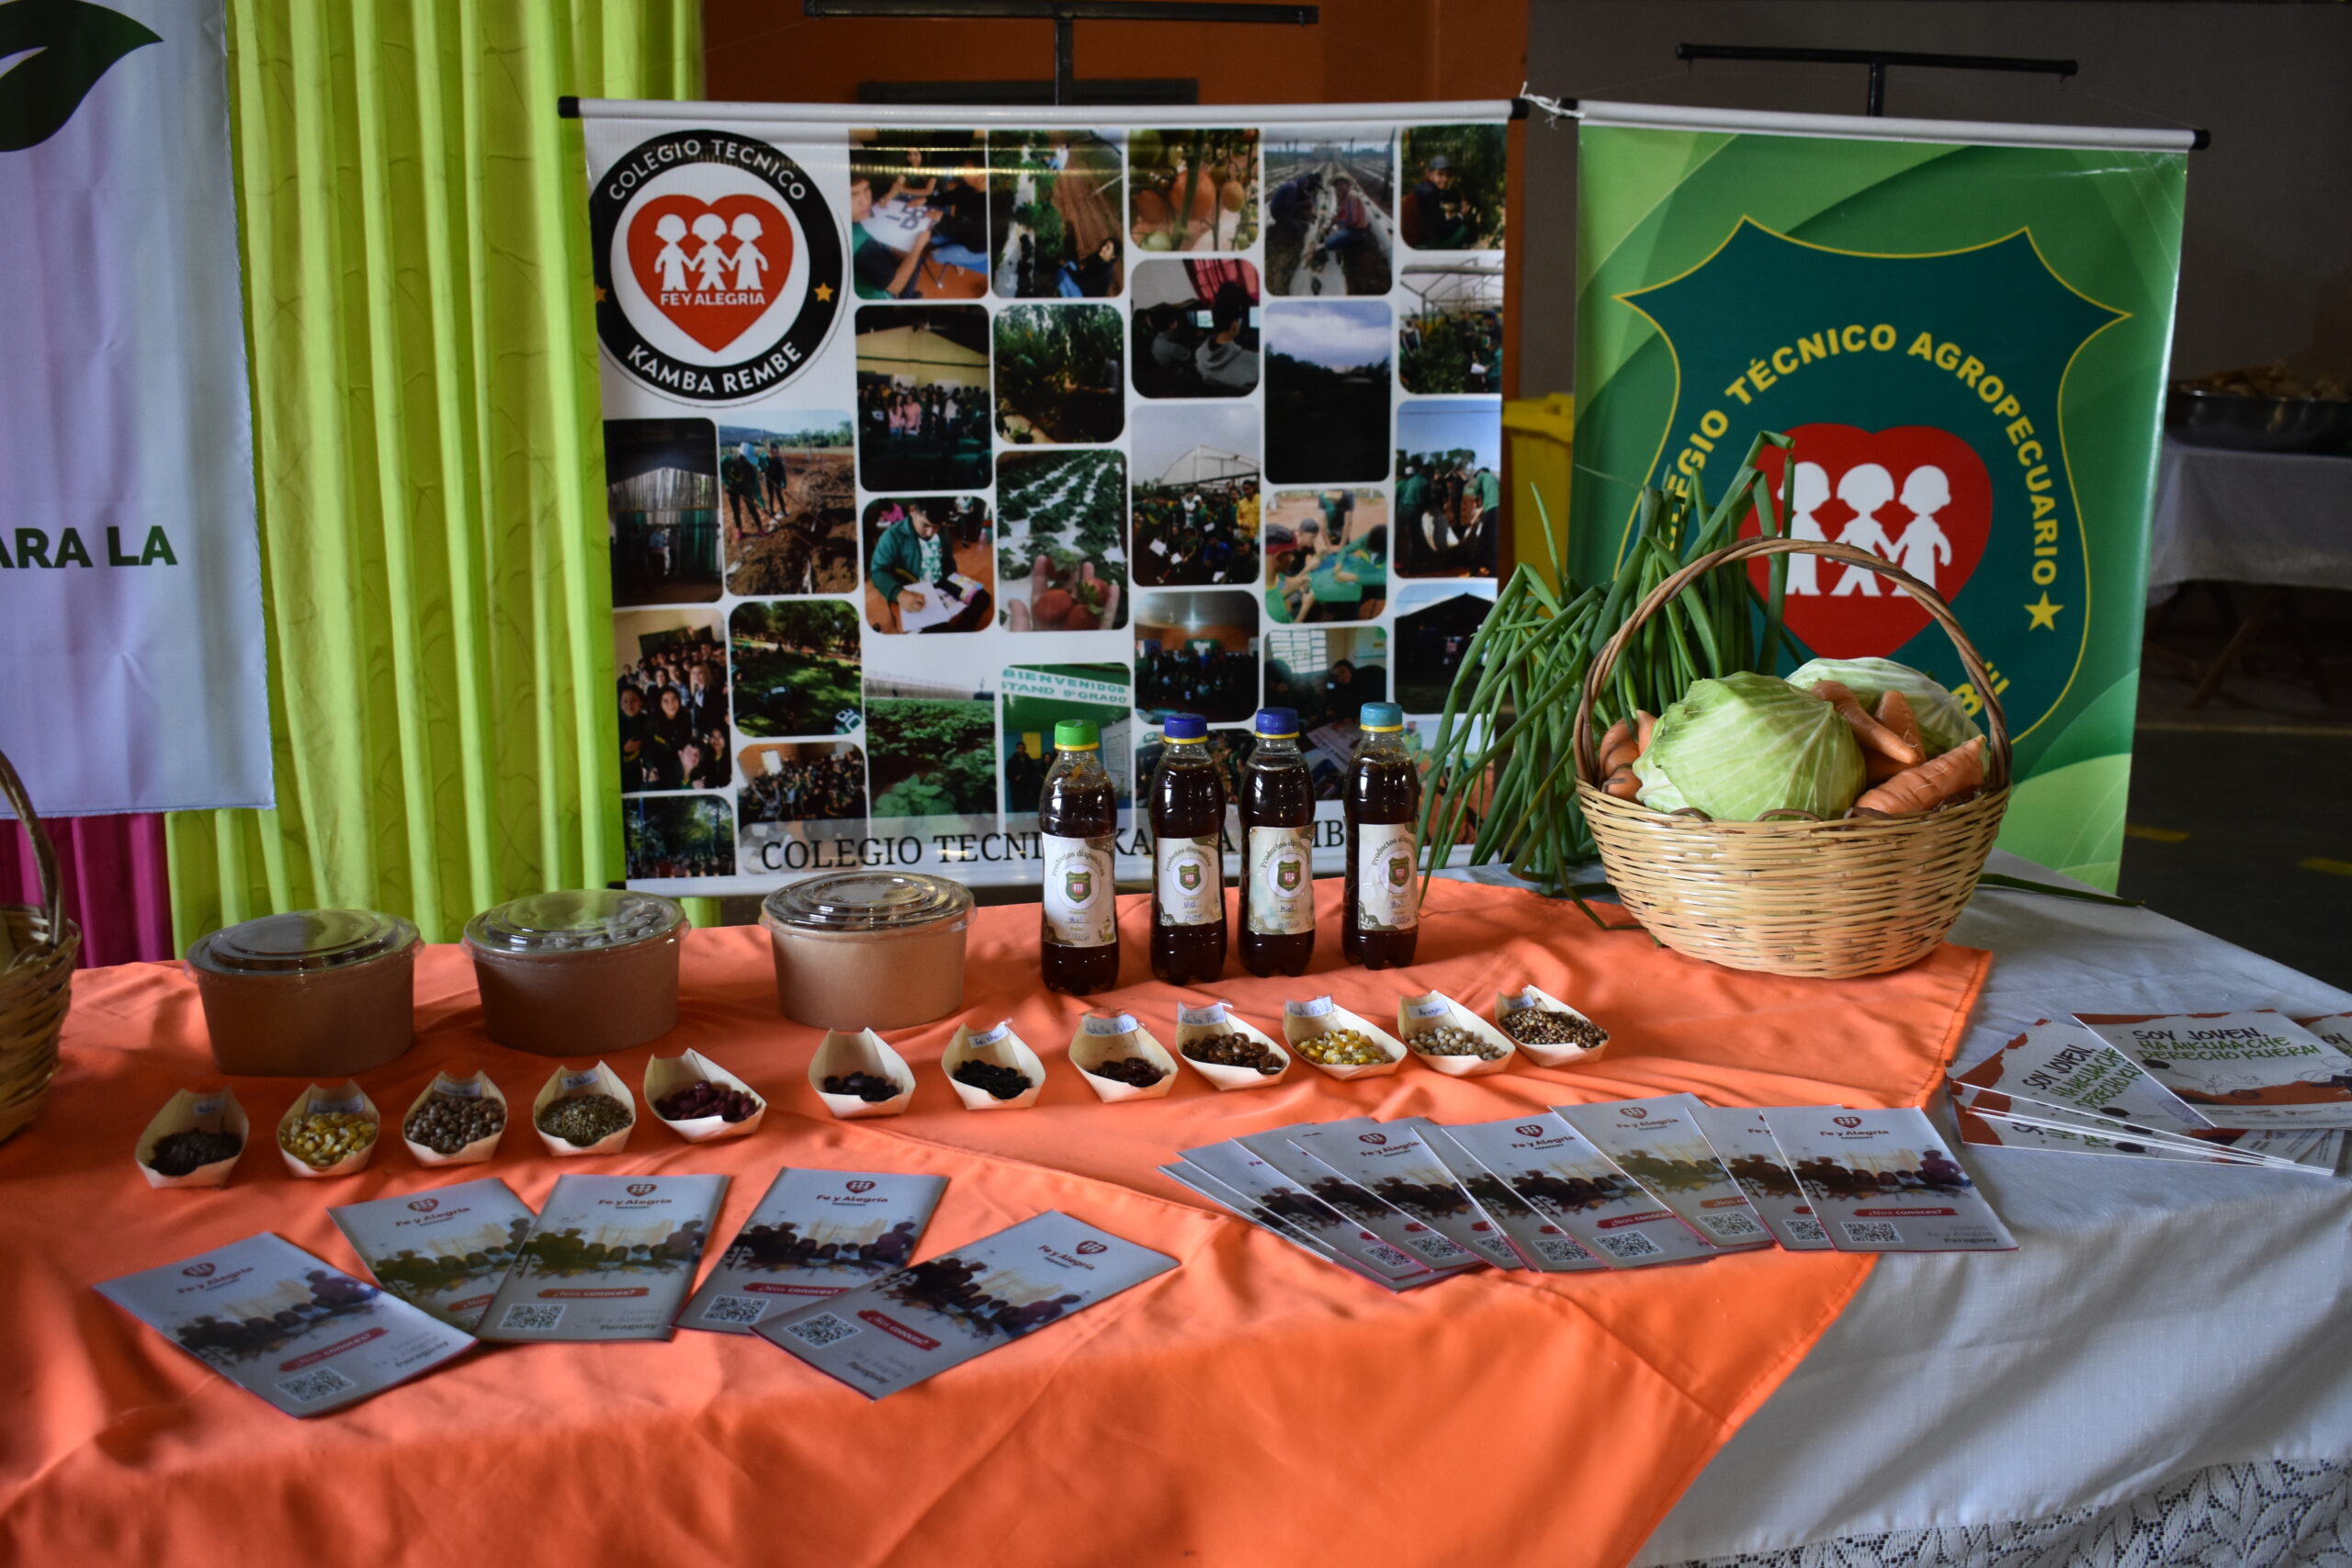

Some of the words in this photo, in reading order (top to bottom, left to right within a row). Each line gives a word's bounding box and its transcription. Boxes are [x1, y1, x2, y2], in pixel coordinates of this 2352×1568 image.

[609, 139, 701, 200] COLEGIO
[711, 139, 806, 200] TECNICO
[660, 292, 680, 306] FE
[682, 292, 692, 306] Y
[695, 292, 766, 306] ALEGRIA
[628, 344, 715, 394] KAMBA
[723, 342, 802, 394] REMBE
[1726, 323, 1897, 403] TÉCNICO
[1907, 332, 2058, 585] AGROPECUARIO
[0, 526, 94, 569] RA
[106, 525, 177, 567] LA
[1002, 668, 1125, 694] BIENVENIDOS
[1078, 691, 1127, 705] GRADO
[761, 835, 922, 870] COLEGIO
[933, 830, 1042, 863] TECNI
[1372, 837, 1397, 866] Productos
[2132, 1030, 2175, 1041] SOY
[2137, 1040, 2168, 1051] HA
[2245, 1036, 2290, 1049] CHE
[2321, 1032, 2352, 1044] OY
[2136, 1050, 2240, 1061] DERECHO
[2022, 1069, 2061, 1090] SOY
[1511, 1141, 1526, 1149] Fe
